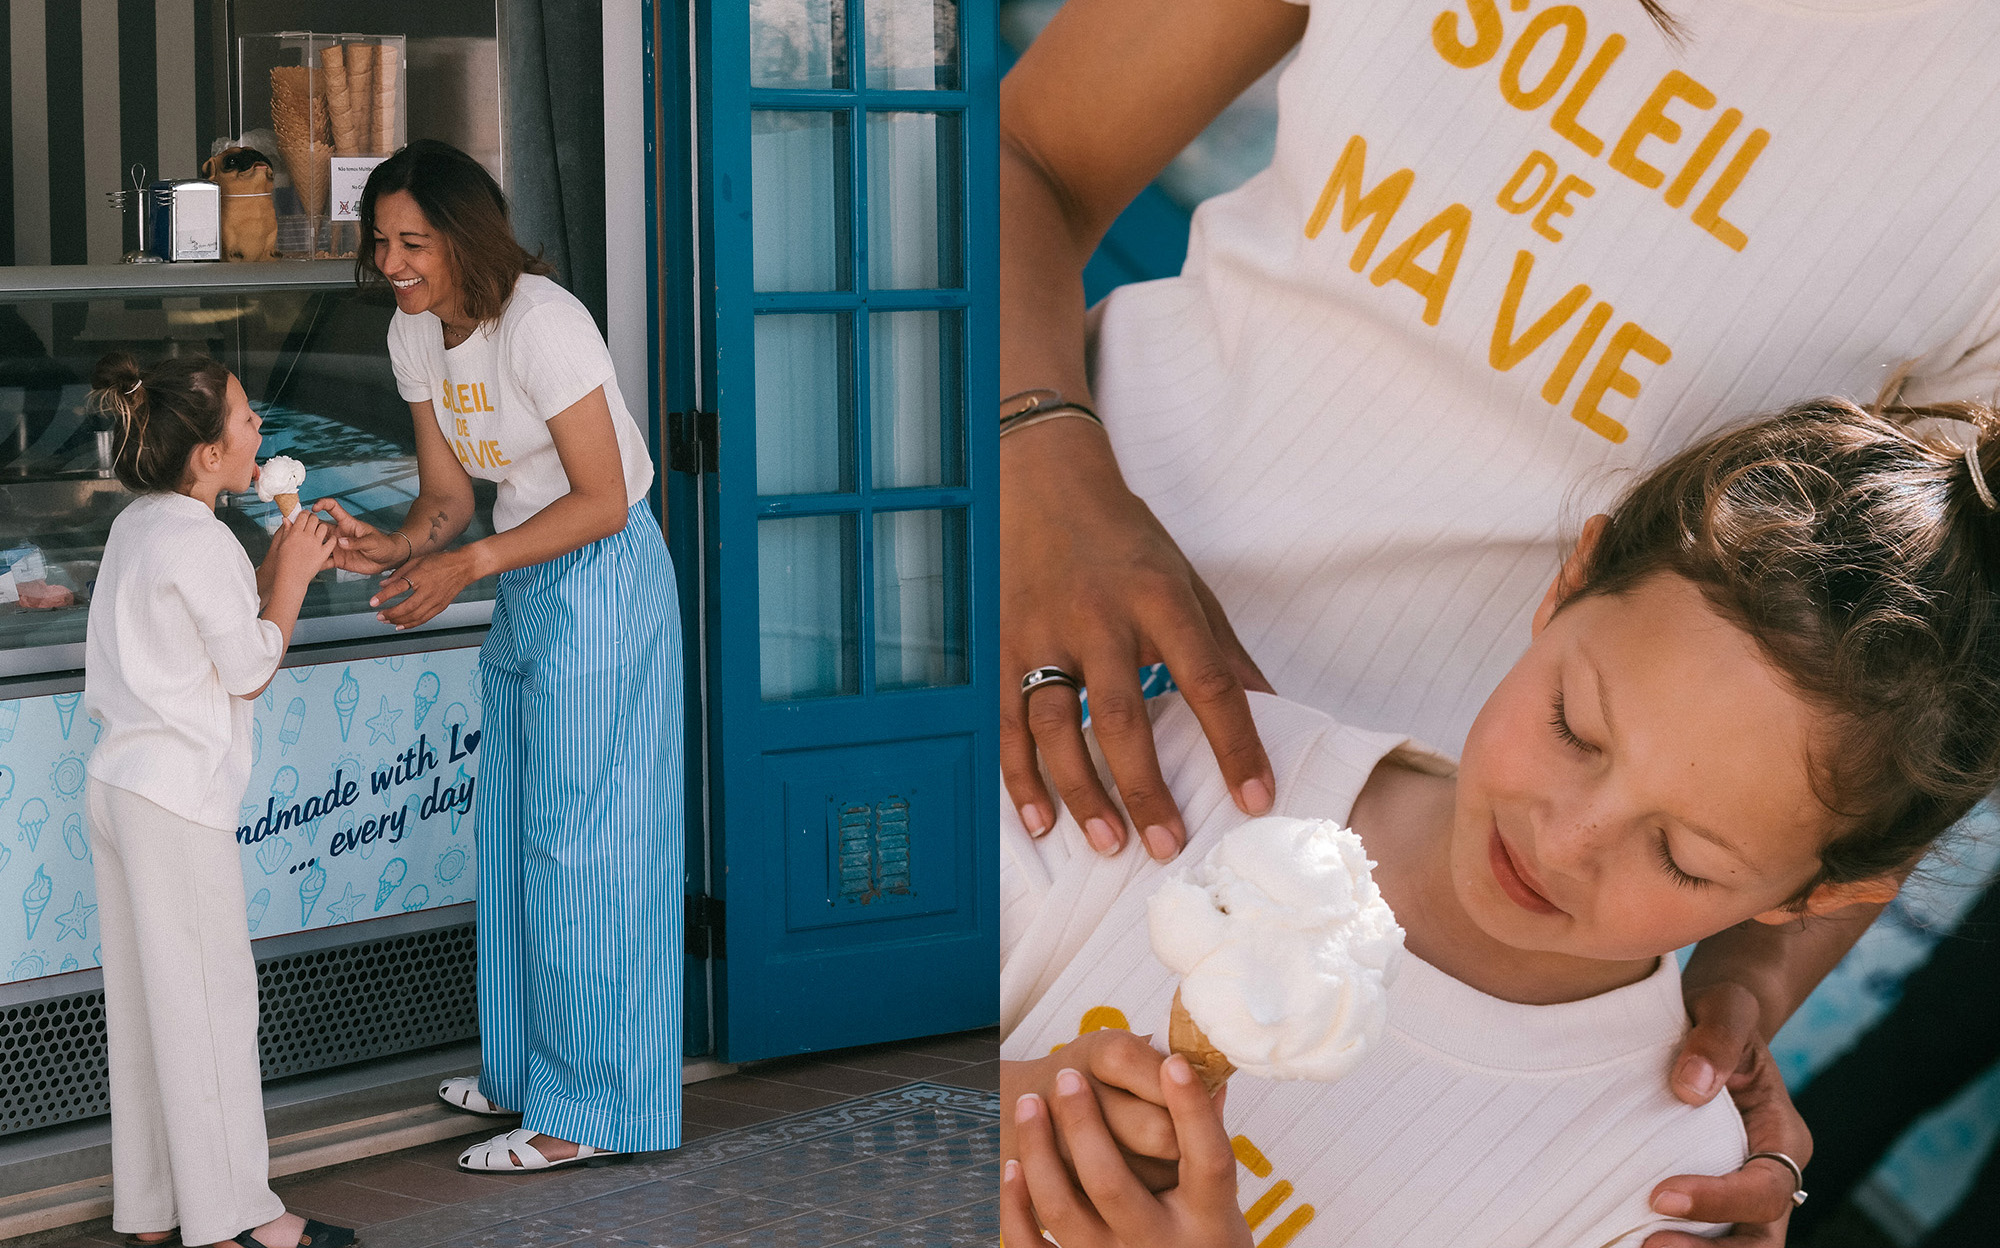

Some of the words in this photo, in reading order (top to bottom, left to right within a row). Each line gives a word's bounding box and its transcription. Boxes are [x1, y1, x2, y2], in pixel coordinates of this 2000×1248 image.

[1432, 0, 1771, 253] SOLEIL
[1496, 149, 1596, 243] DE
[1304, 134, 1472, 327] MA
[1488, 249, 1672, 445] VIE
[442, 378, 495, 414] SLEIL
[455, 418, 470, 437] DE
[447, 438, 473, 468] A
[467, 440, 512, 469] VIE
[235, 769, 360, 845] ndmade
[370, 733, 439, 795] with
[329, 804, 408, 857] every
[420, 776, 476, 821] day
